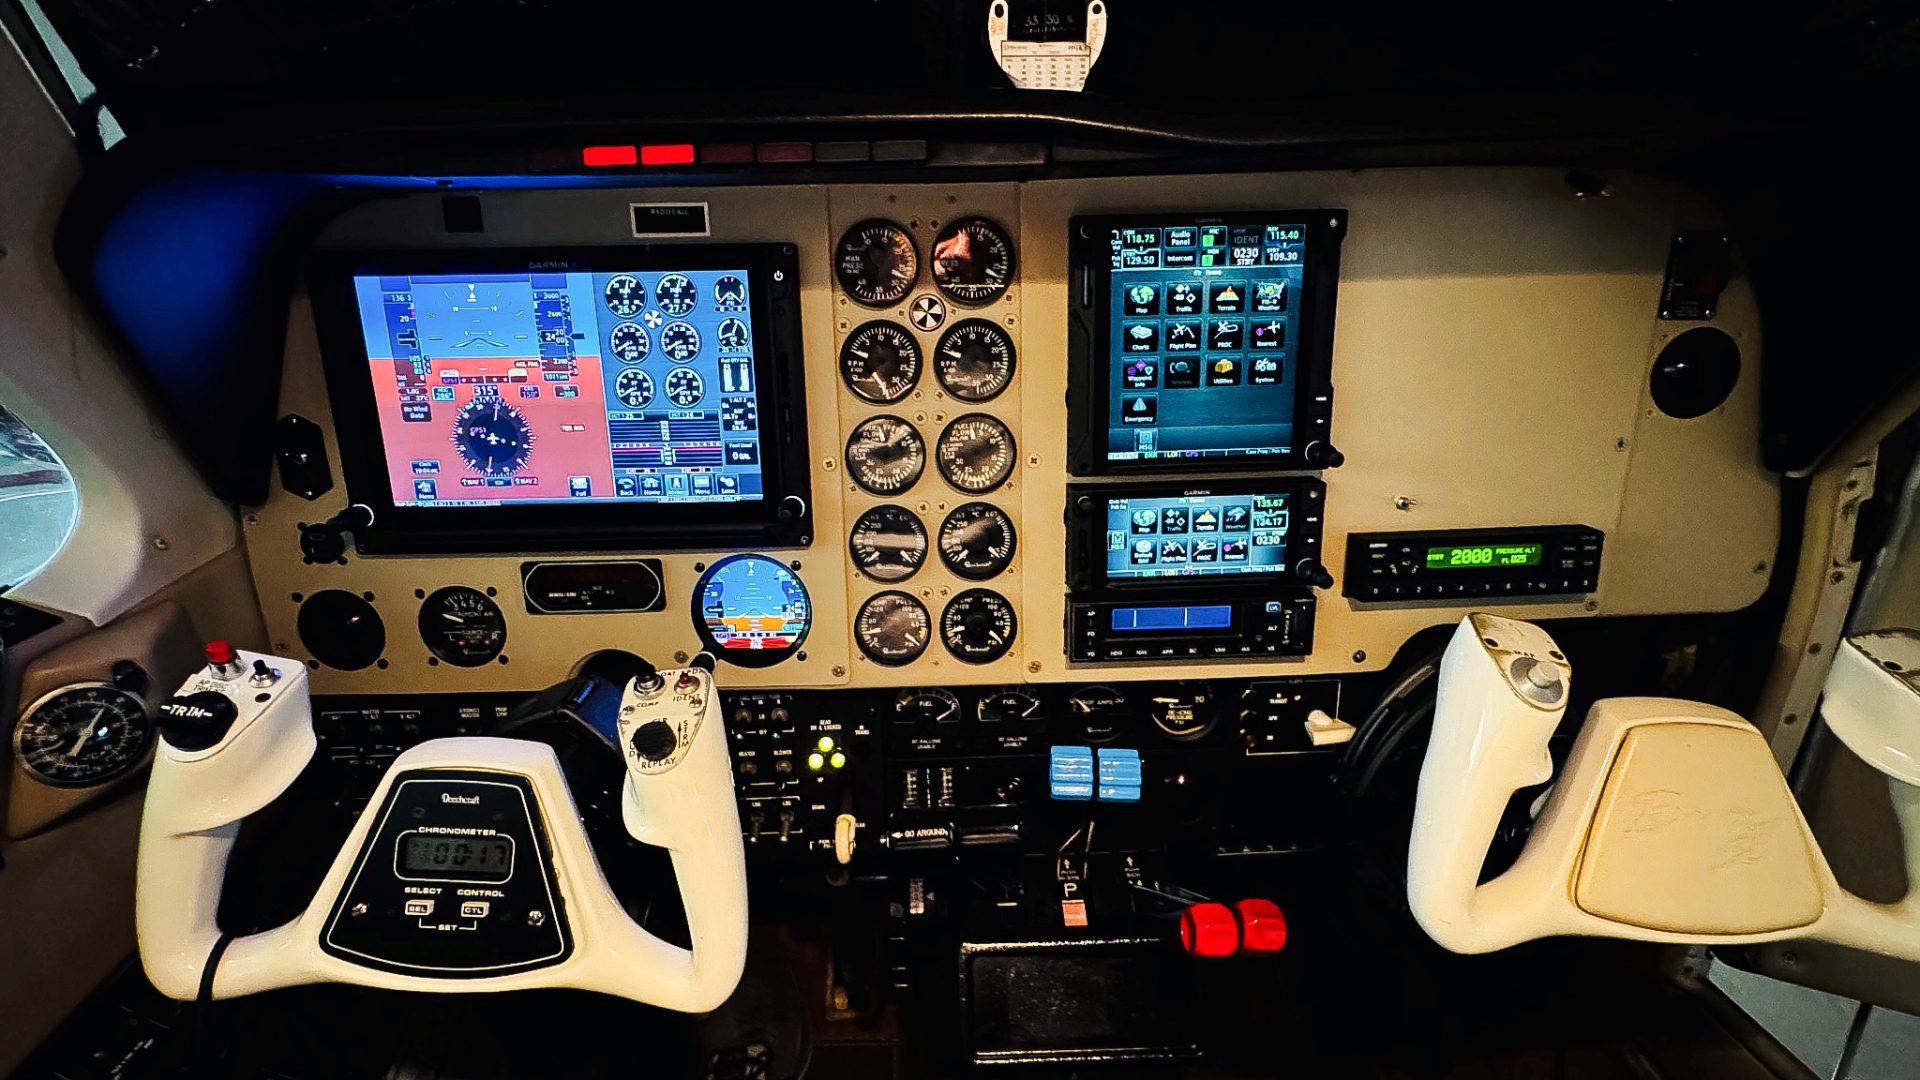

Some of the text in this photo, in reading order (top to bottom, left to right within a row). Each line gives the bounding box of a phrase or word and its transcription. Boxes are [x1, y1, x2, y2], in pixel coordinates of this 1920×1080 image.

[1126, 235, 1155, 244] 118.75
[1234, 236, 1259, 245] IDENT
[1270, 231, 1299, 241] 115.40
[1171, 238, 1191, 246] Panel
[1234, 248, 1259, 259] 0230
[1270, 253, 1298, 262] 109.30
[529, 261, 568, 269] GARMIN
[1126, 256, 1155, 265] 129.50
[1236, 258, 1254, 266] STBY
[1257, 517, 1283, 526] 124.17
[1256, 536, 1280, 545] 0230
[1496, 547, 1524, 555] PRESSURE
[1451, 548, 1493, 564] 2000
[469, 600, 475, 608] 5
[477, 603, 484, 611] 6
[491, 632, 498, 641] R
[673, 693, 701, 703] IDENT
[897, 703, 902, 712] E
[952, 702, 957, 711] F
[641, 757, 677, 769] REPLAY
[441, 793, 481, 805] Beechcraft
[418, 826, 497, 837] CHRONOMETER
[904, 827, 945, 838] GO AROUND
[405, 887, 443, 895] SELECT
[457, 889, 505, 899] CONTROL
[1064, 882, 1078, 898] P
